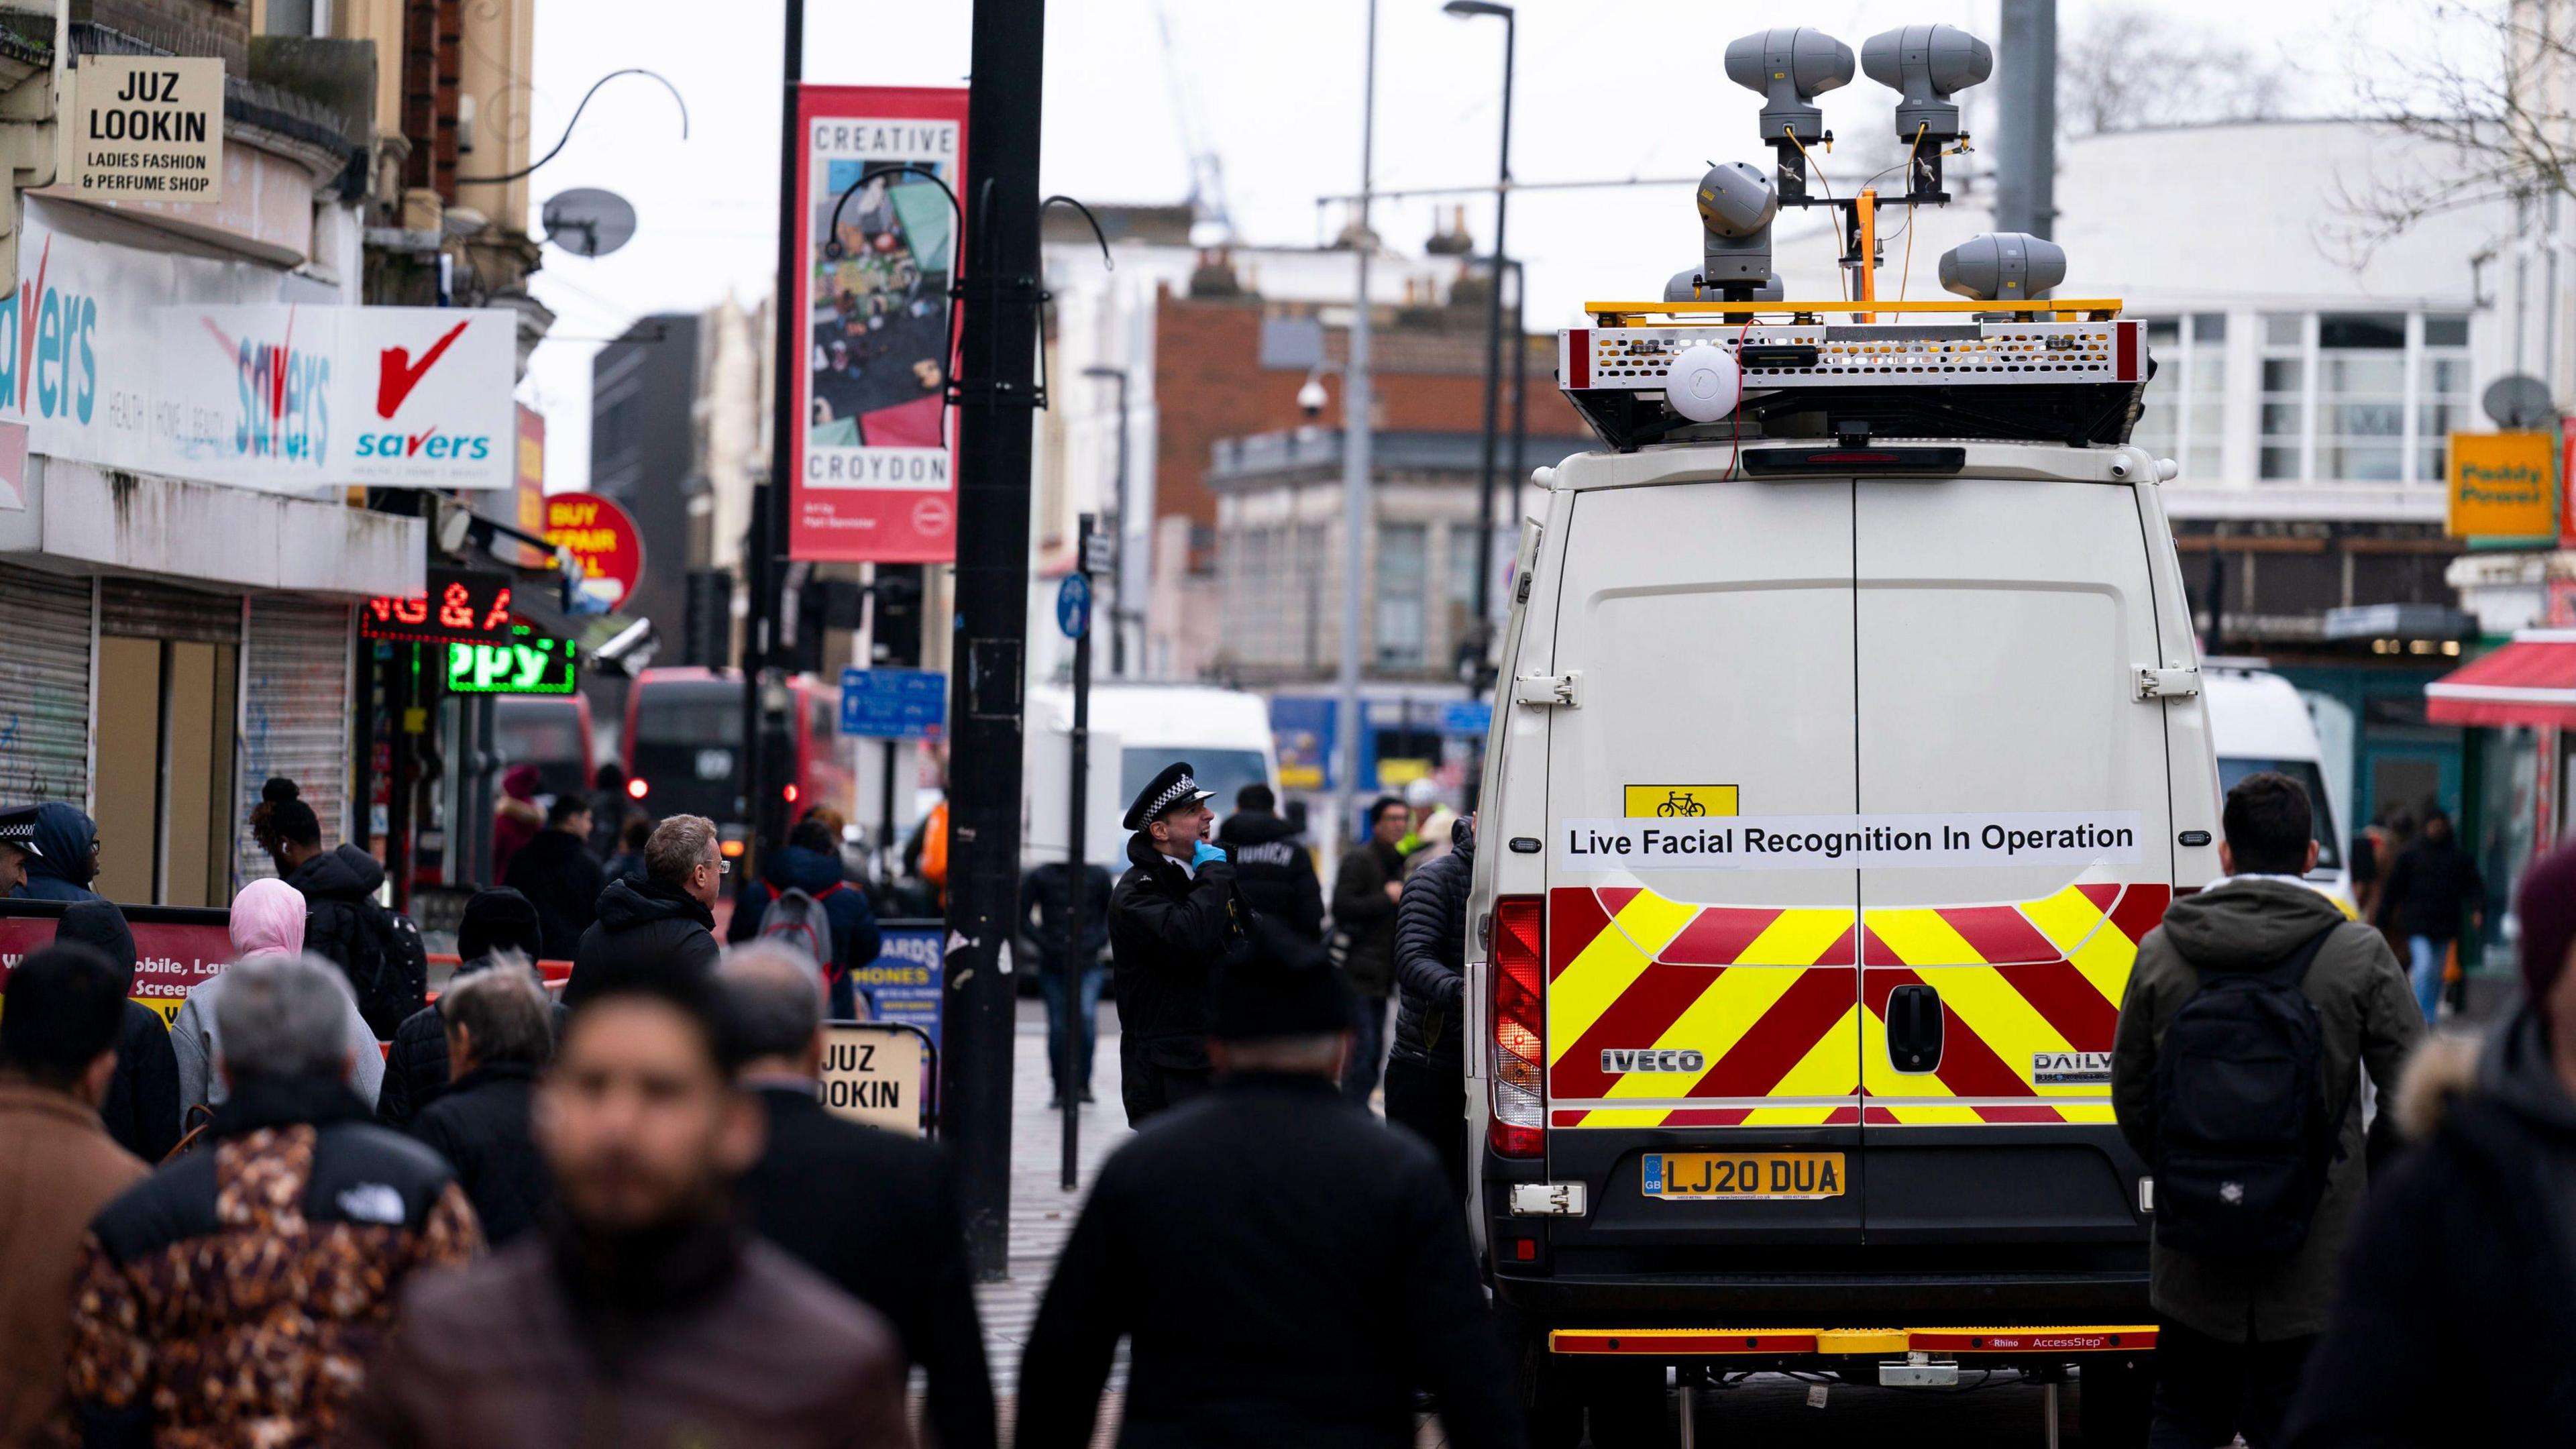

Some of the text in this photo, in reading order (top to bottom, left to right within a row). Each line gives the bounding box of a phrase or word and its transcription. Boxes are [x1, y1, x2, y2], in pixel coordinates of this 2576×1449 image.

[118, 71, 179, 102] JUZ
[90, 109, 205, 142] LOOKIN
[814, 126, 954, 153] CREATIVE
[88, 152, 205, 170] LADIES FASHION
[83, 173, 209, 192] & PERFUME SHOP
[355, 427, 490, 460] savers
[809, 455, 946, 481] CROYDON
[549, 503, 599, 527] BUY
[440, 582, 474, 629] &
[1570, 823, 2133, 859] Live Facial Recognition In Operation
[134, 958, 188, 976] obile,
[880, 938, 938, 970] ARDS
[851, 968, 929, 984] HONES
[822, 1044, 875, 1071] JUZ
[1602, 1051, 1704, 1072] IVECO
[2035, 1054, 2113, 1069] DAILY
[816, 1080, 899, 1108] OOKIN
[1645, 1181, 1662, 1189] GB
[1668, 1160, 1838, 1192] LJ20 DUA
[1994, 1339, 2019, 1347] Rhino
